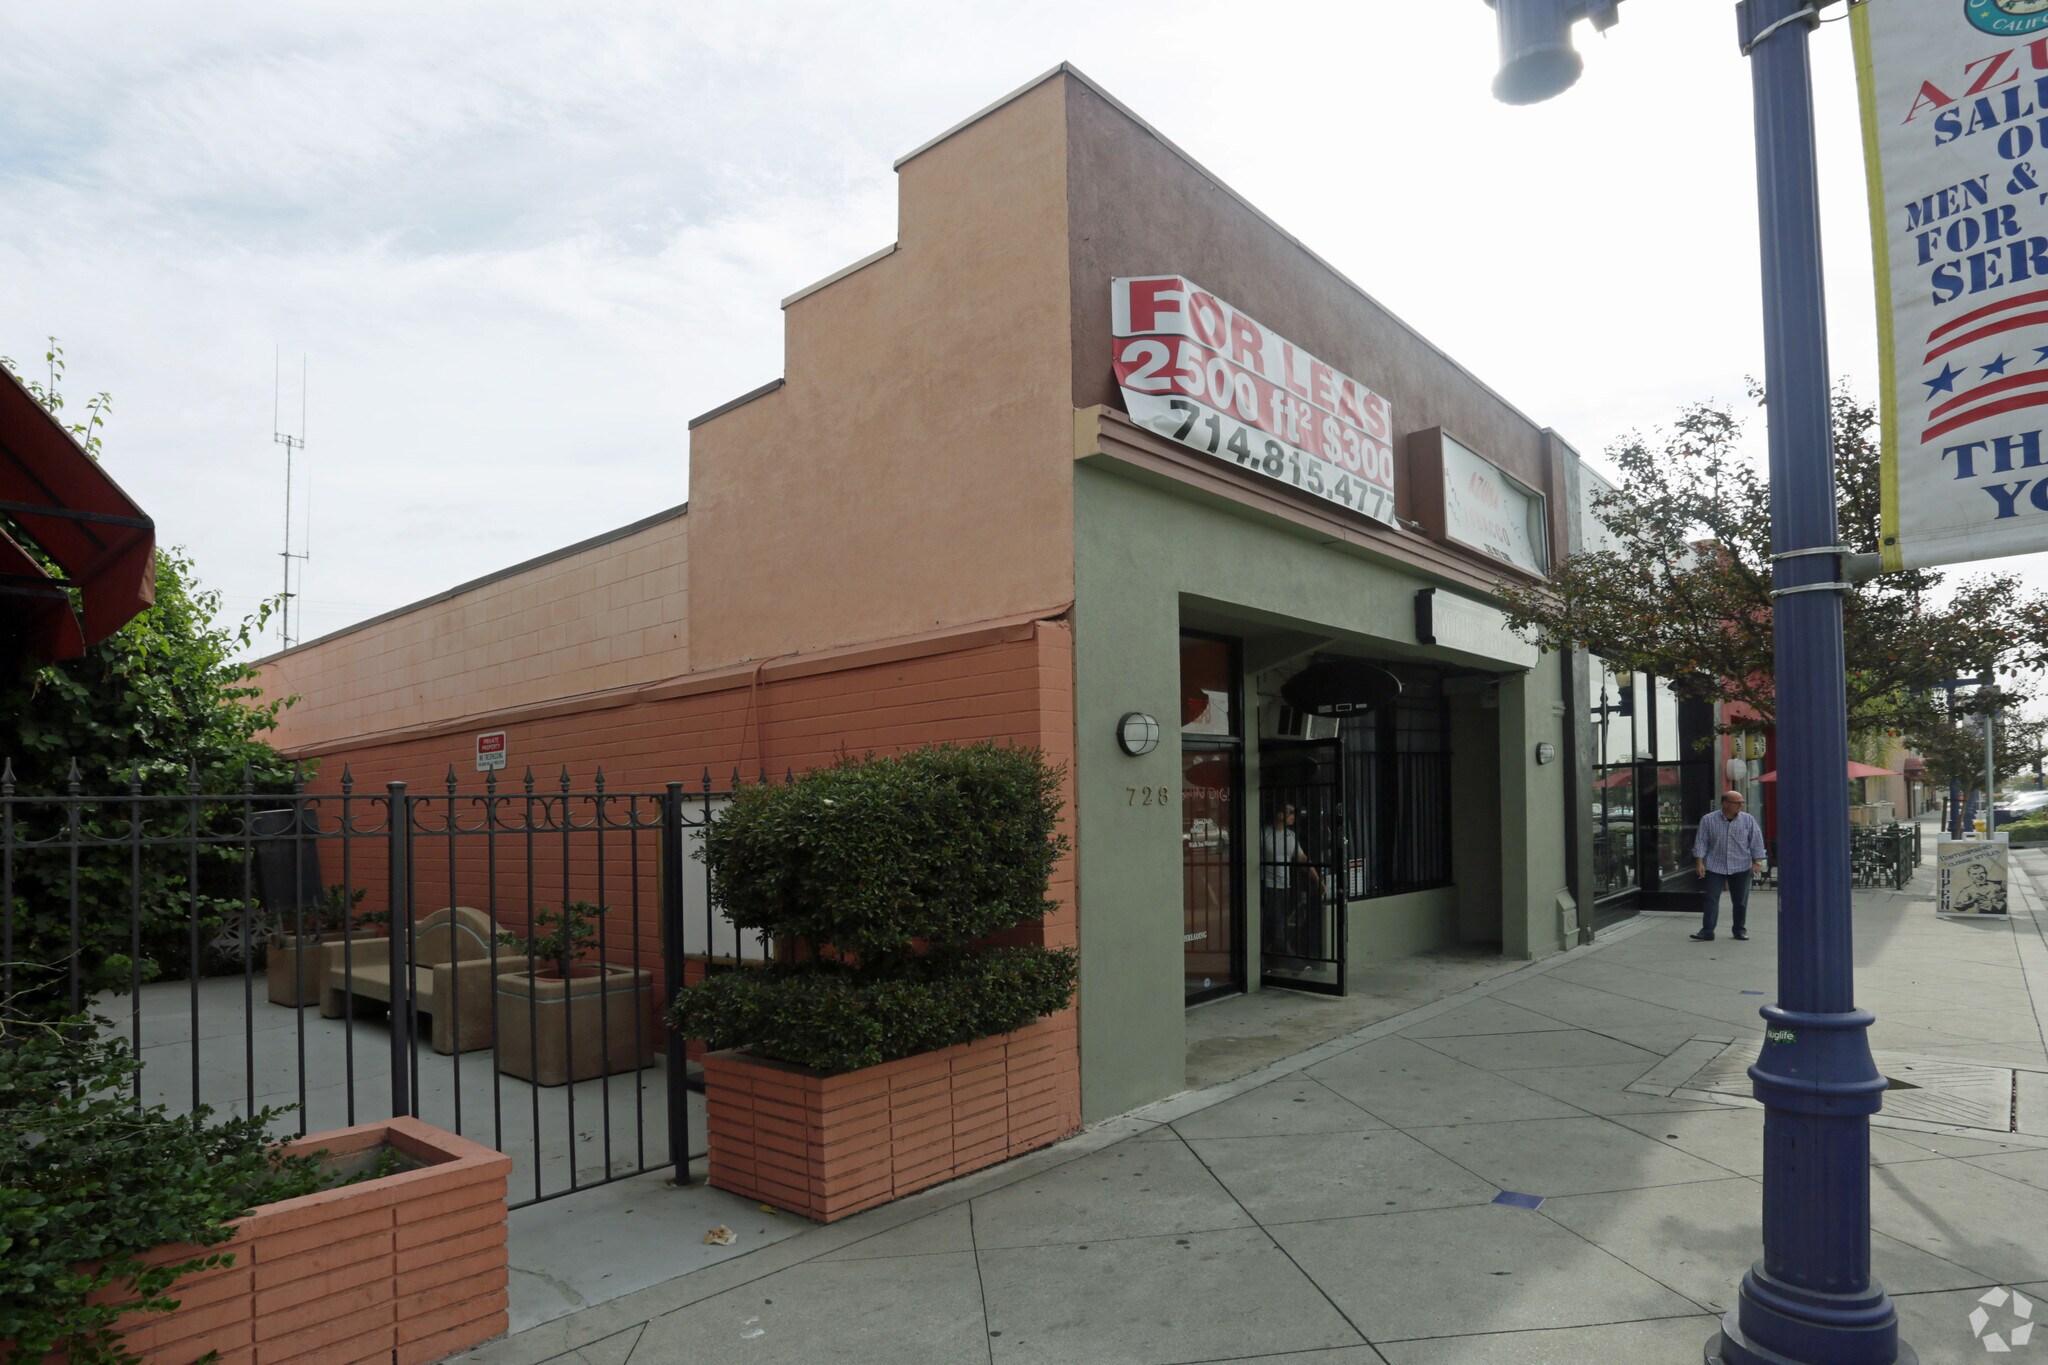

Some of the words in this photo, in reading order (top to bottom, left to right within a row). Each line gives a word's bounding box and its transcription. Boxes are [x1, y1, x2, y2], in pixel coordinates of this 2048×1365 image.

[1904, 173, 1990, 232] MEN
[2006, 161, 2039, 195] &
[1916, 204, 2022, 266] FOR
[1931, 236, 2048, 306] SER
[1129, 278, 1266, 376] FOR
[1282, 341, 1392, 439] LEAS
[1120, 339, 1258, 421] 2500
[1322, 415, 1394, 488] $300
[1126, 785, 1169, 806] 728
[1941, 868, 1951, 910] OPEN
